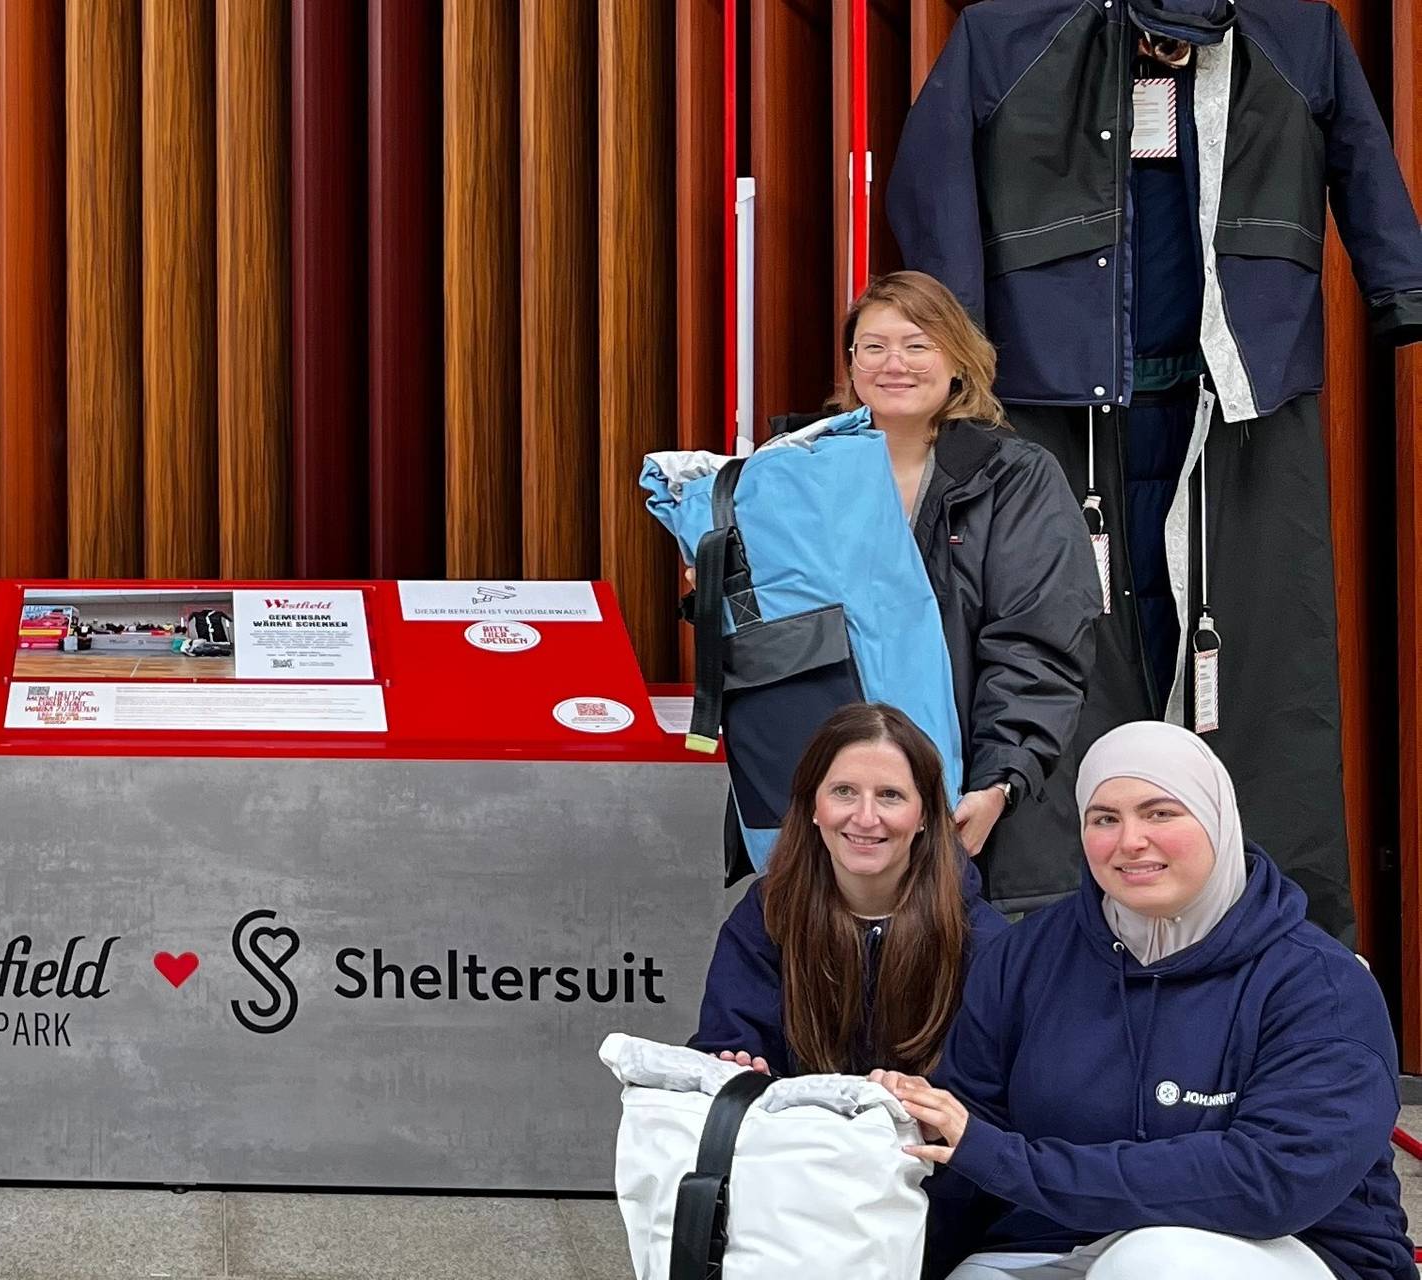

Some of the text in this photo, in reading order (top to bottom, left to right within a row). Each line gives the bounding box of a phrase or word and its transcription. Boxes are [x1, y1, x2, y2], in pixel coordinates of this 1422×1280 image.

[264, 599, 332, 609] Westfield
[479, 637, 529, 645] SPENDEN
[333, 946, 667, 1004] Sheltersuit
